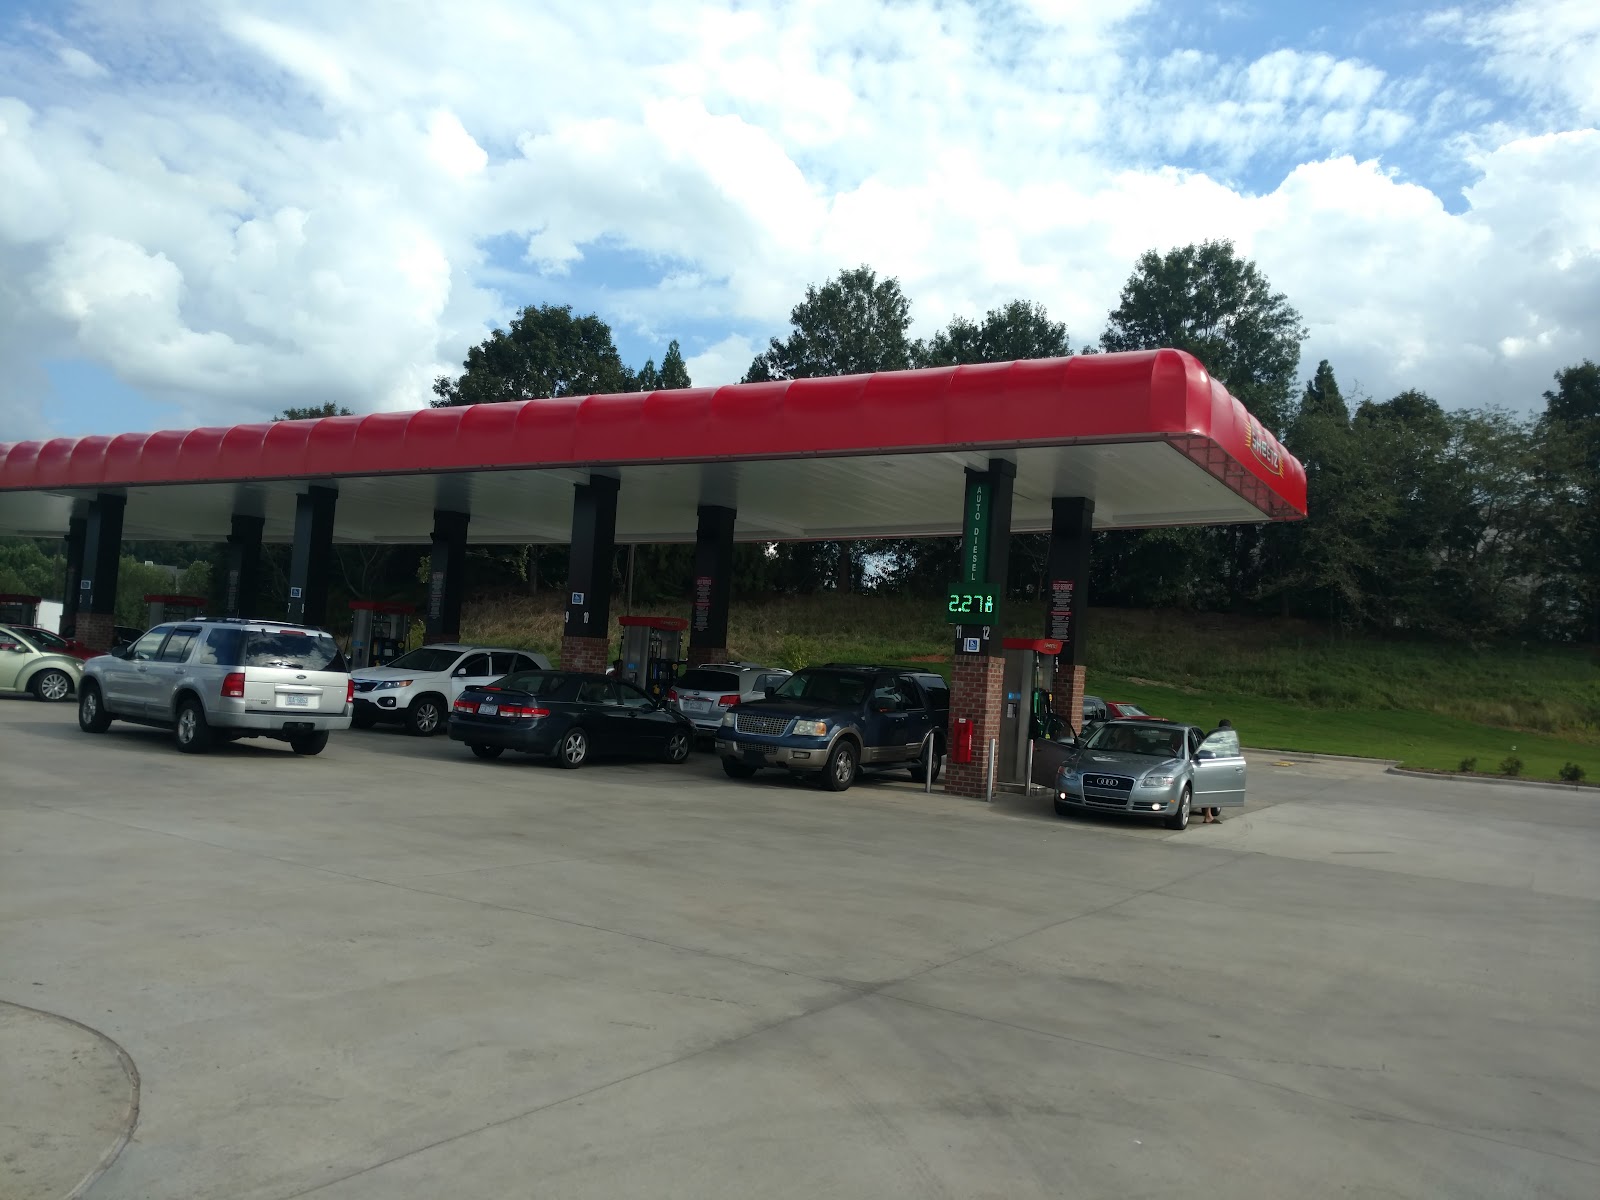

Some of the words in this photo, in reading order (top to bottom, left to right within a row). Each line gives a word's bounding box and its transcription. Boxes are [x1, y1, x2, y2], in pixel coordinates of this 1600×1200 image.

[1252, 432, 1279, 469] SHEETZ
[971, 527, 979, 581] DIESEL
[956, 624, 962, 639] 11
[982, 625, 990, 640] 12
